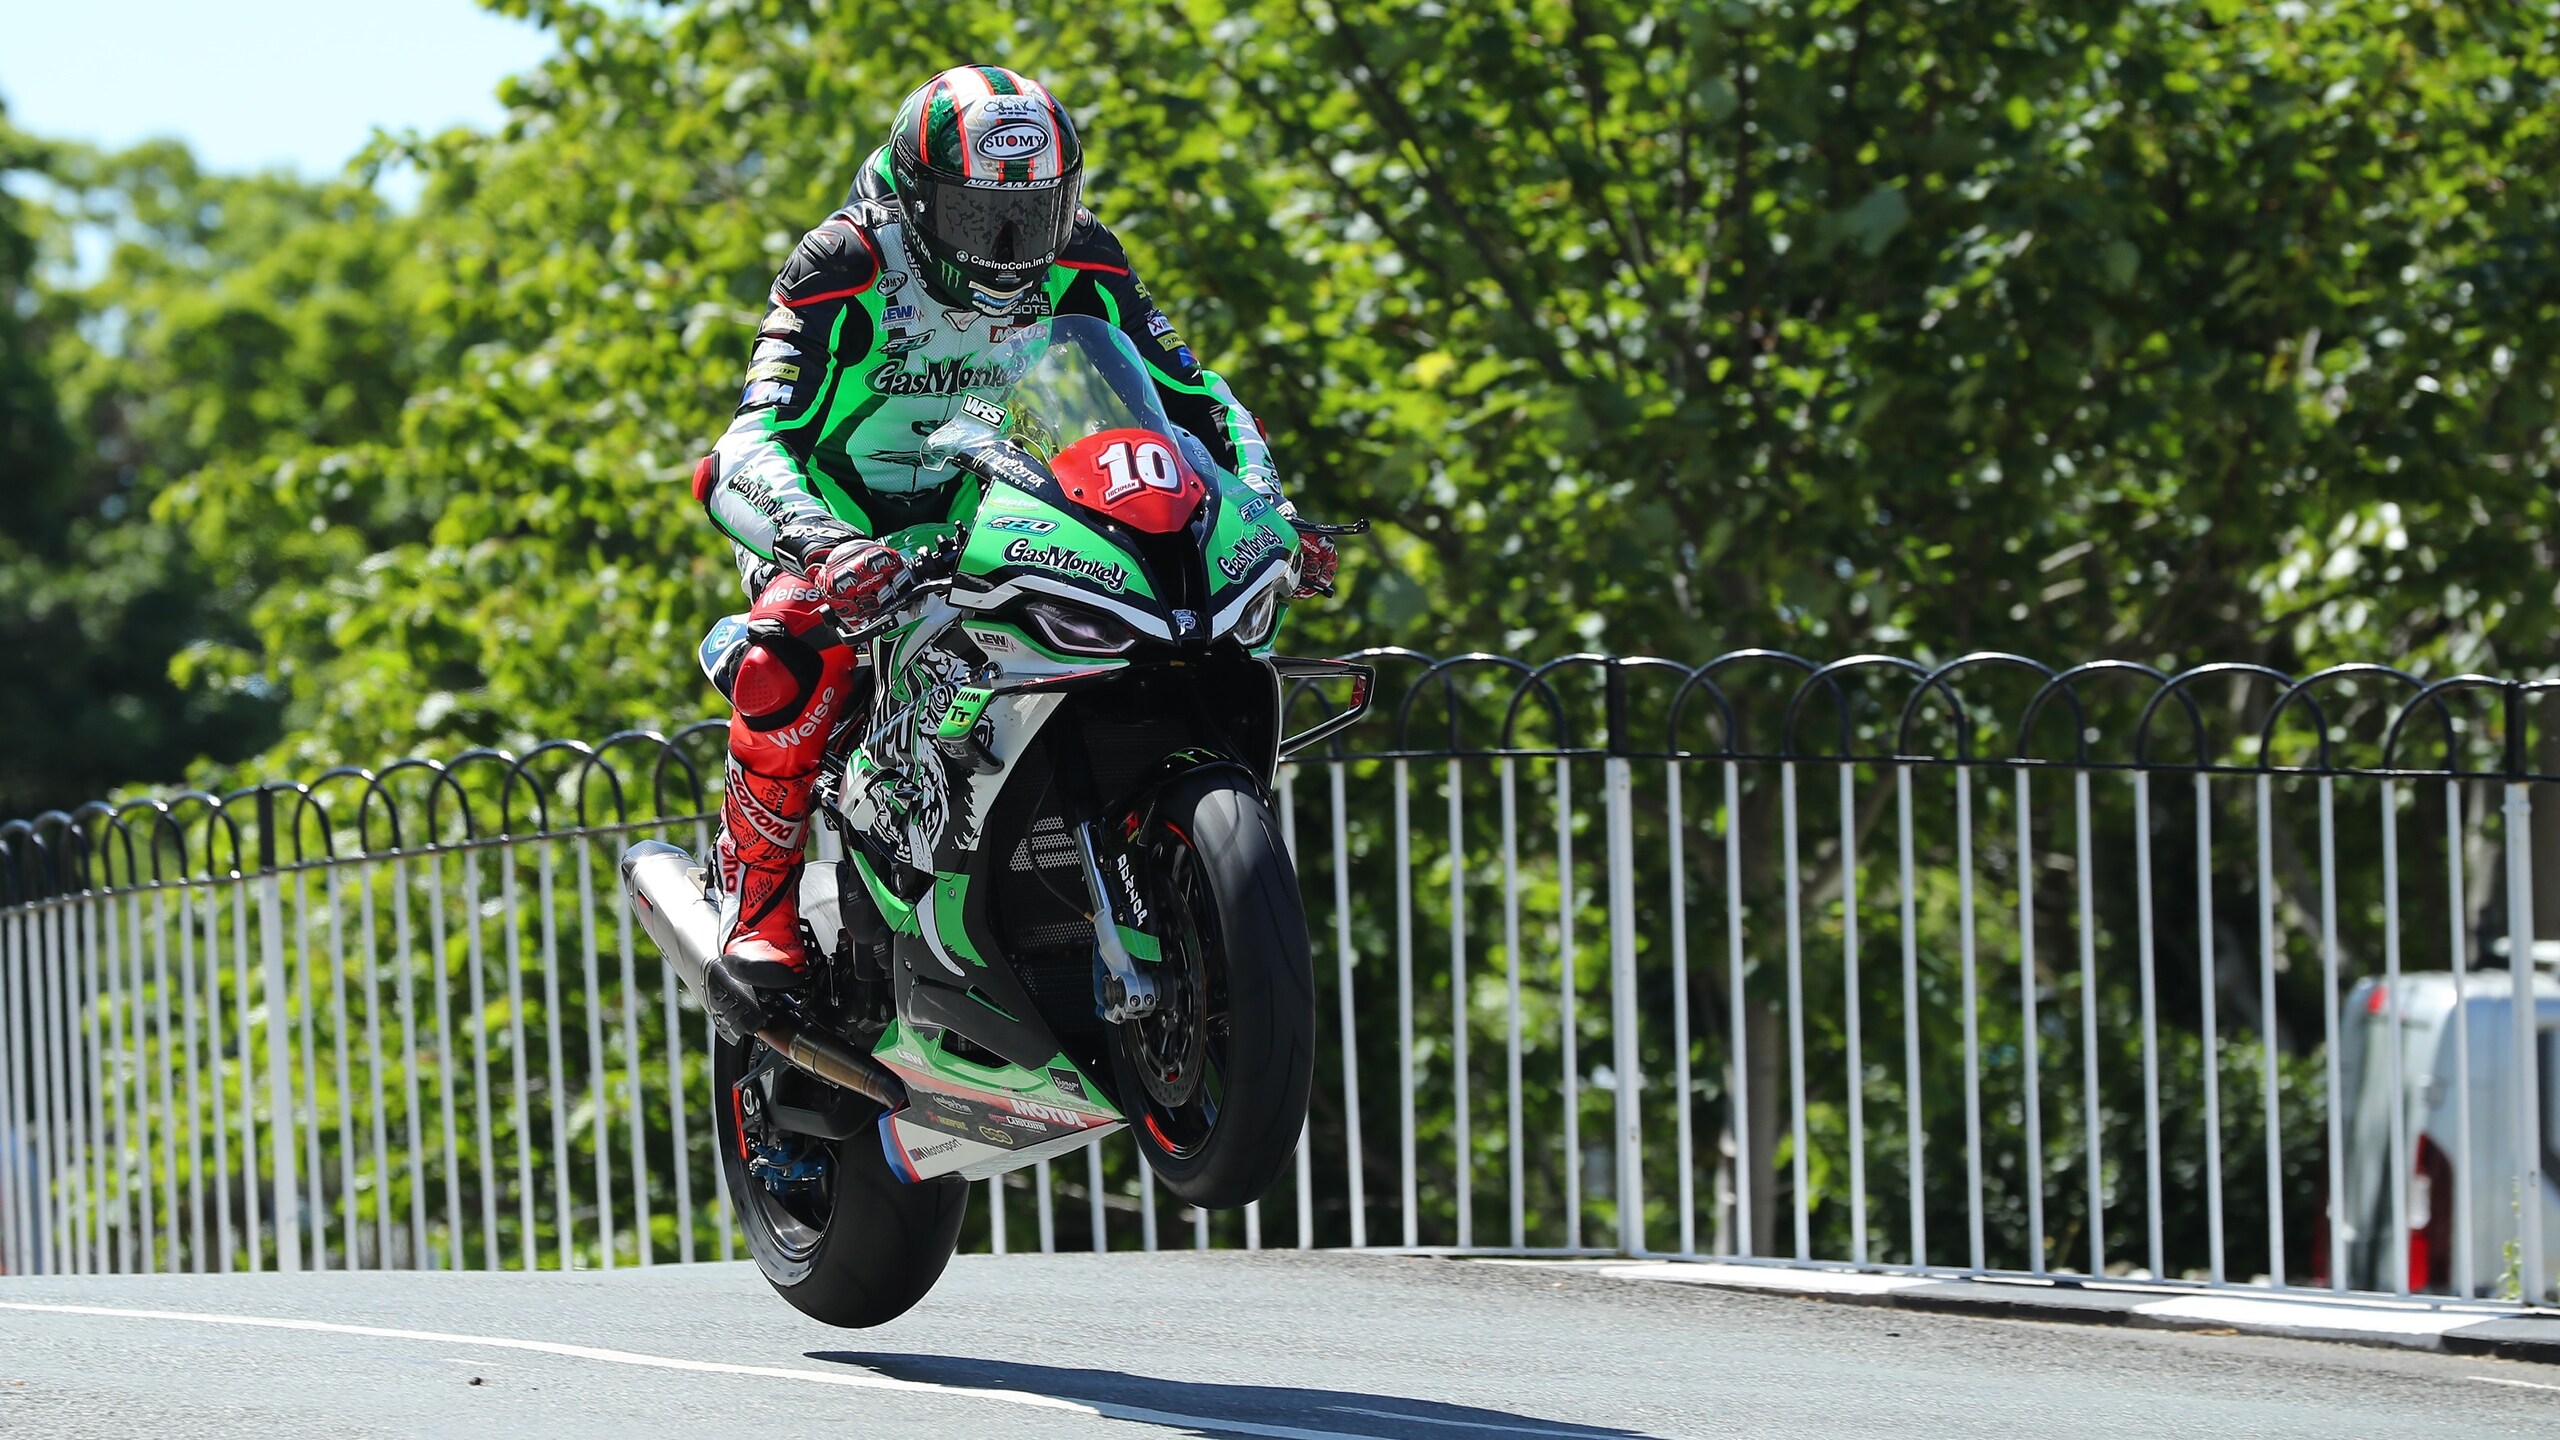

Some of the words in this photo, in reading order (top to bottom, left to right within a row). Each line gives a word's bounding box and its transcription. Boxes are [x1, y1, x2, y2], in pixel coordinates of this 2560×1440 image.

[985, 134, 1044, 148] SUOMY
[967, 178, 1027, 188] NOLAN
[970, 255, 1045, 270] CasinoCoin.im
[964, 396, 1004, 425] WRS
[1097, 442, 1178, 501] 10
[1002, 538, 1130, 592] GasMonkey
[1218, 524, 1284, 583] GasMonkey
[762, 584, 819, 608] Weise
[974, 631, 1006, 647] LEW
[766, 686, 835, 749] Weise
[951, 705, 972, 723] TT
[1117, 853, 1148, 927] DUNLOP
[1010, 1099, 1088, 1128] MOTUL
